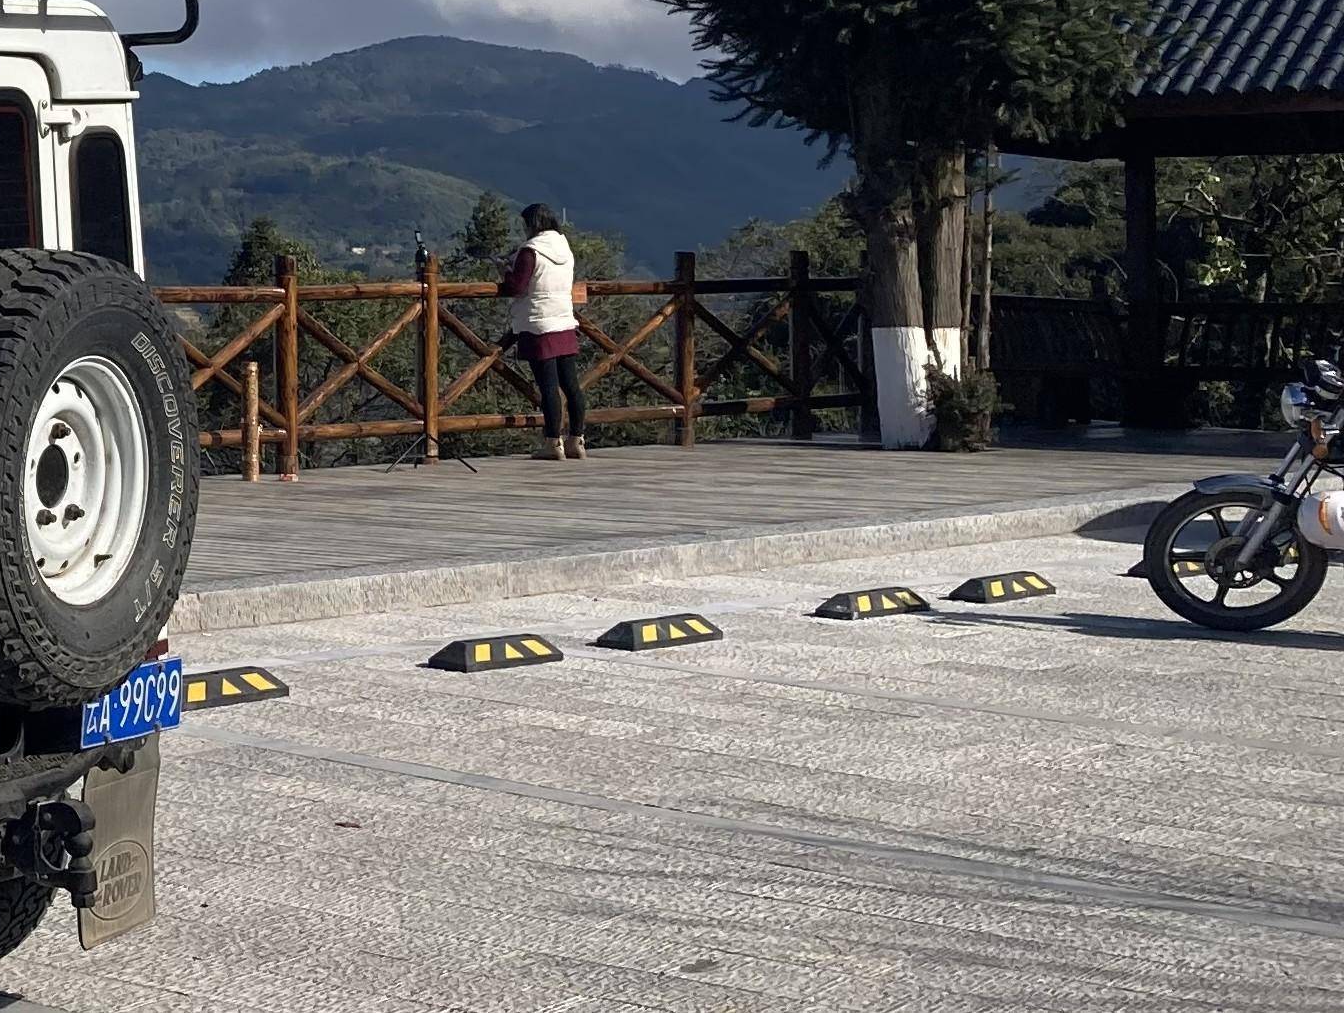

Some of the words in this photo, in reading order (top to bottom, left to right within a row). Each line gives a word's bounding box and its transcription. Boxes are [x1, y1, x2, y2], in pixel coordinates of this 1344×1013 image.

[131, 331, 184, 549] DISCOVERER
[133, 559, 165, 623] S/T
[99, 851, 132, 884] LAND
[102, 871, 142, 908] ROVER
